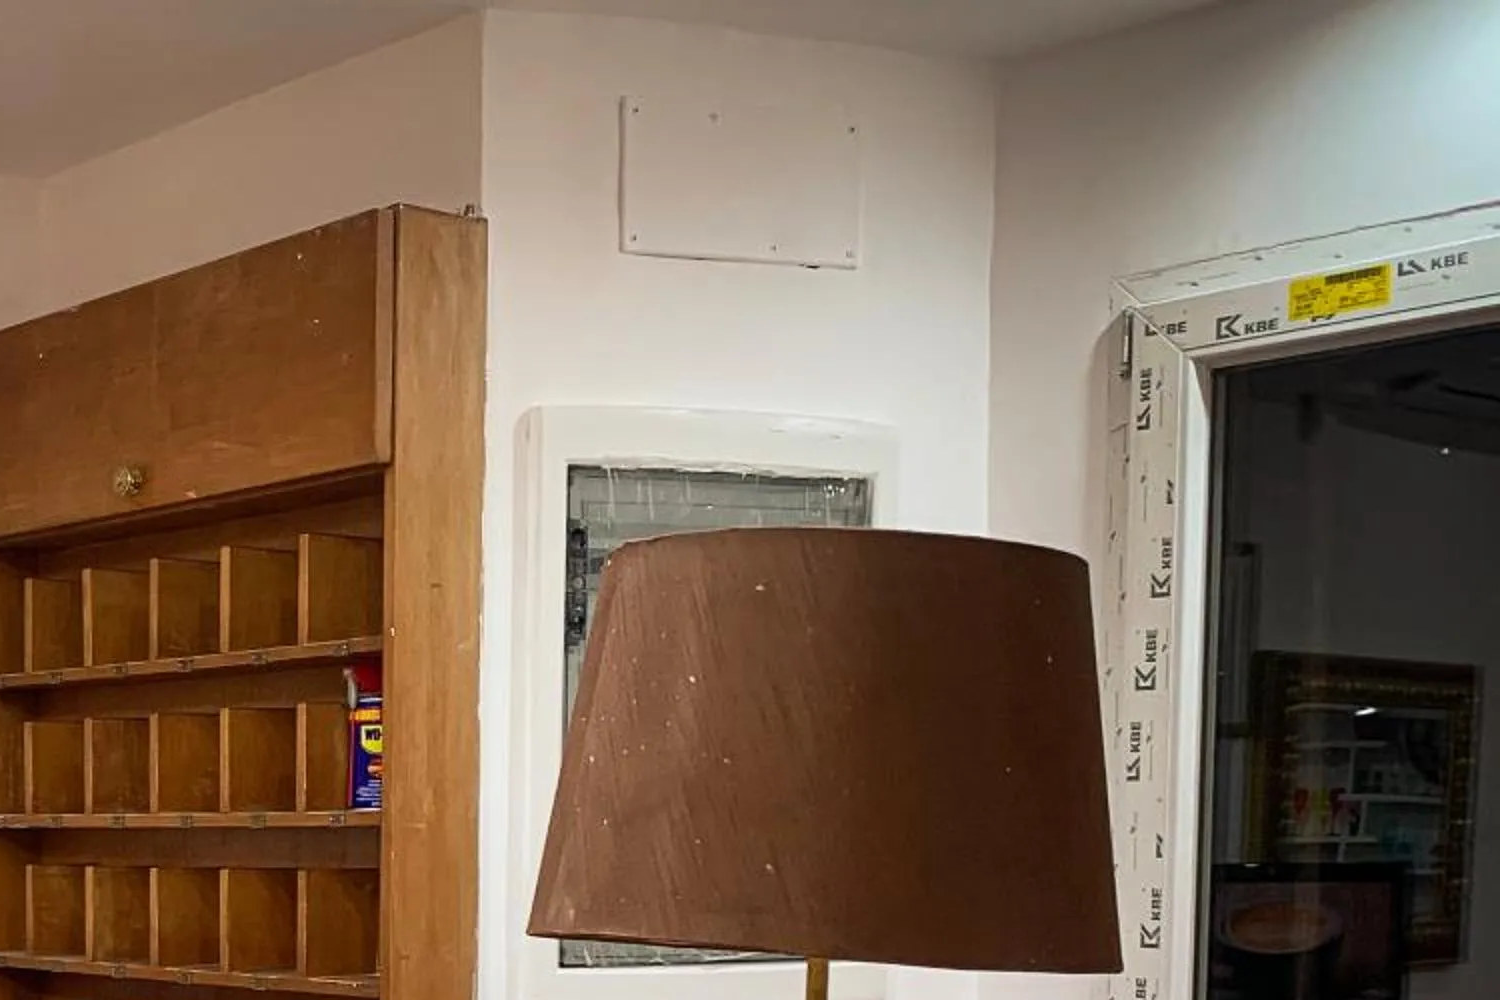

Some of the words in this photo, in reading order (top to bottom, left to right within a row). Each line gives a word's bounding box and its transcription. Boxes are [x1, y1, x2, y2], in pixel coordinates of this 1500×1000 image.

[1430, 250, 1469, 272] KBE
[1243, 317, 1280, 335] KBE
[1145, 629, 1157, 663] KBE
[1130, 721, 1141, 753] KBE
[1150, 887, 1163, 921] KBE
